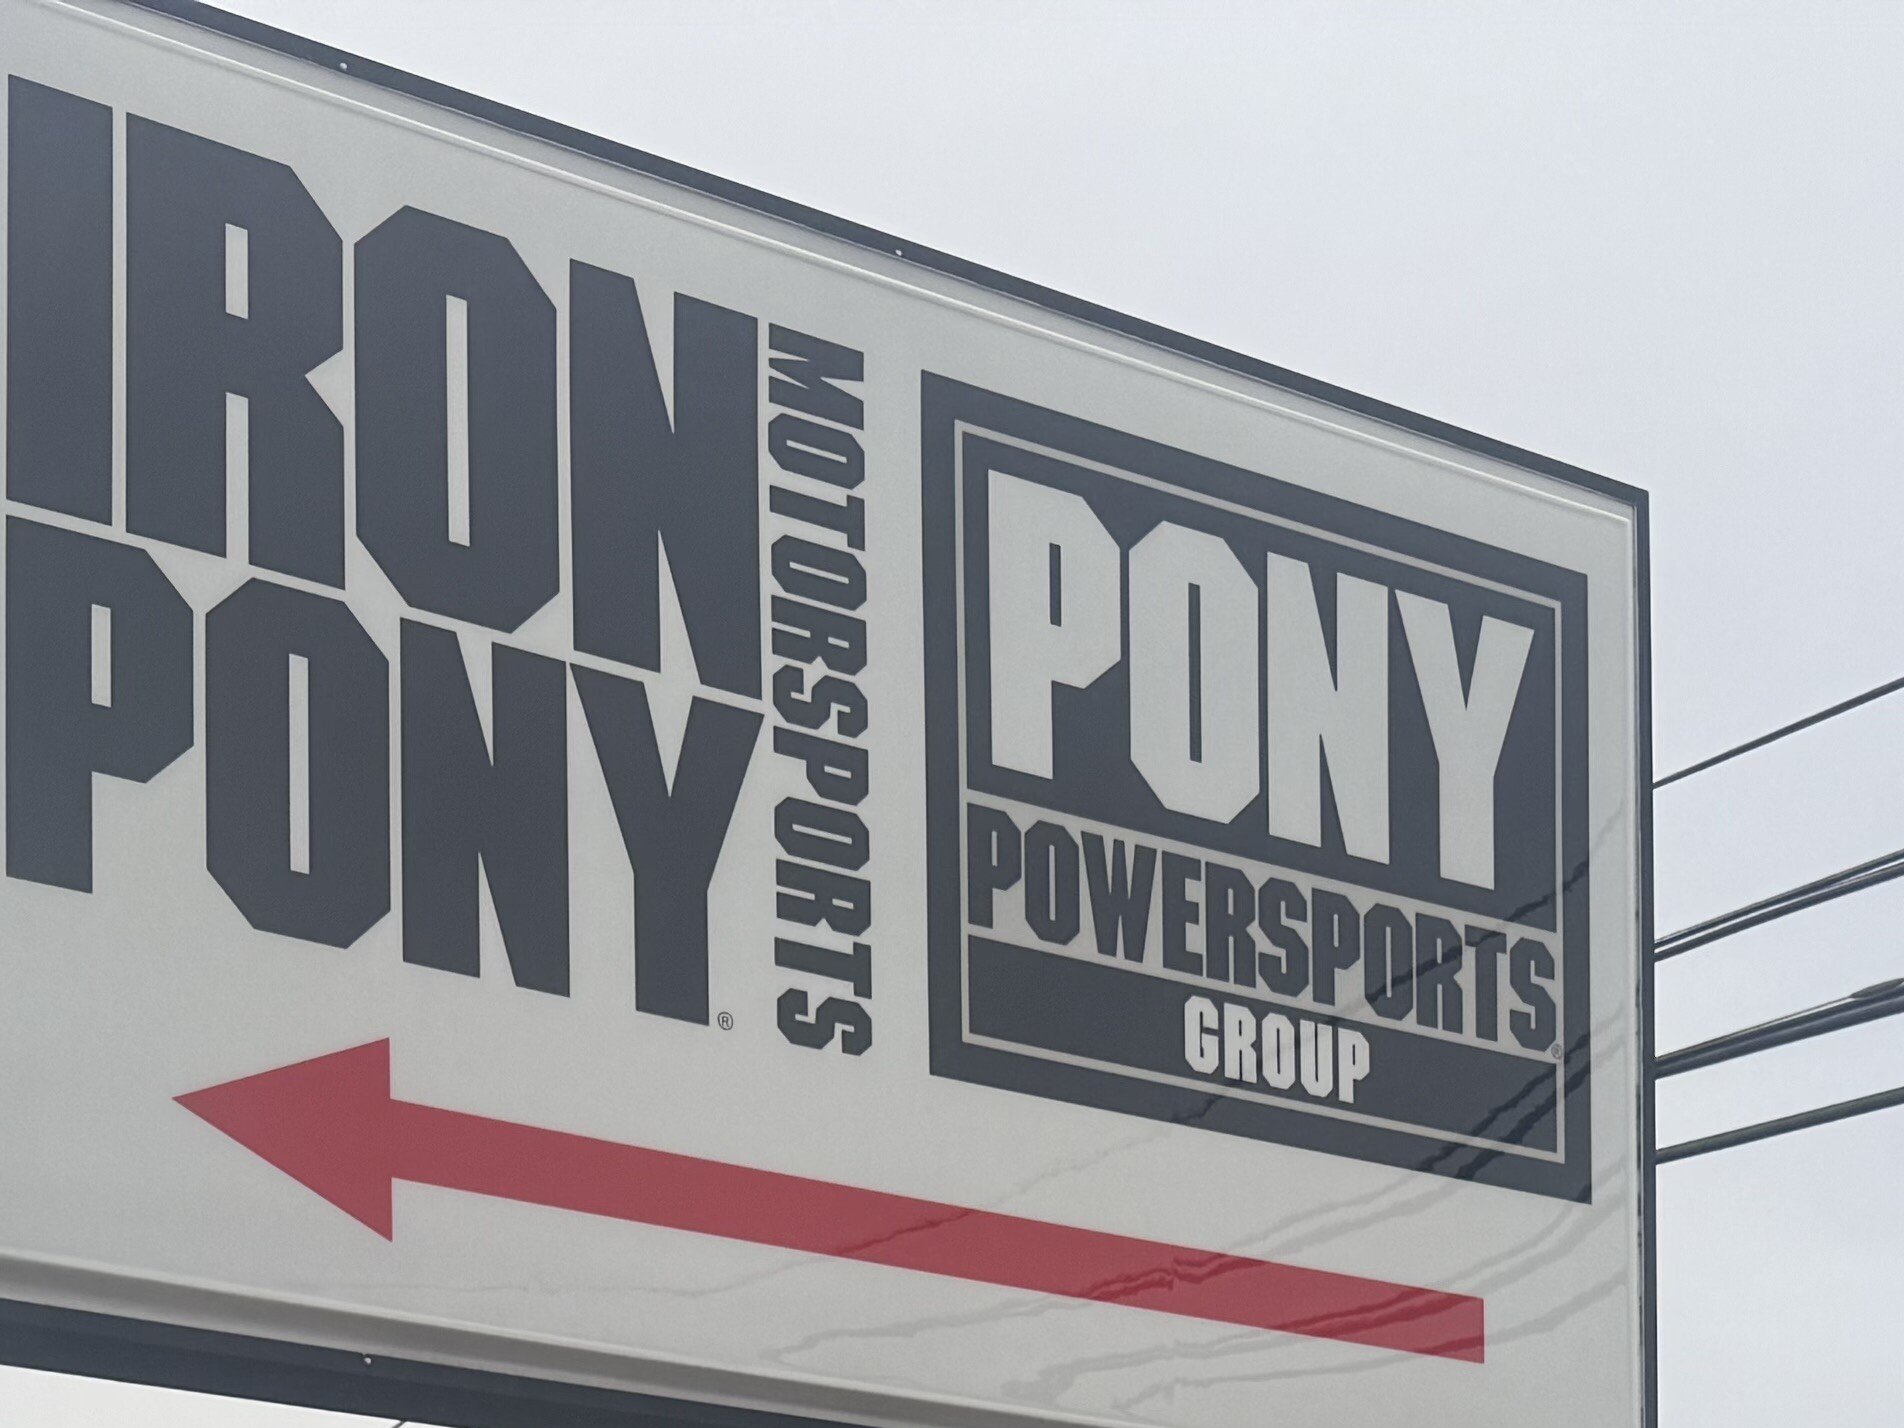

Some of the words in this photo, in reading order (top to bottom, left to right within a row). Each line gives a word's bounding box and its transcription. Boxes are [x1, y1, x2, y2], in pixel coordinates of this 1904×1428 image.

[6, 74, 763, 701] IRON
[5, 514, 765, 1026] PONY
[767, 322, 873, 1057] MOTORSPORTS
[987, 468, 1536, 891] PONY
[966, 802, 1557, 1053] POWERSPORTS
[1184, 994, 1371, 1105] GROUP
